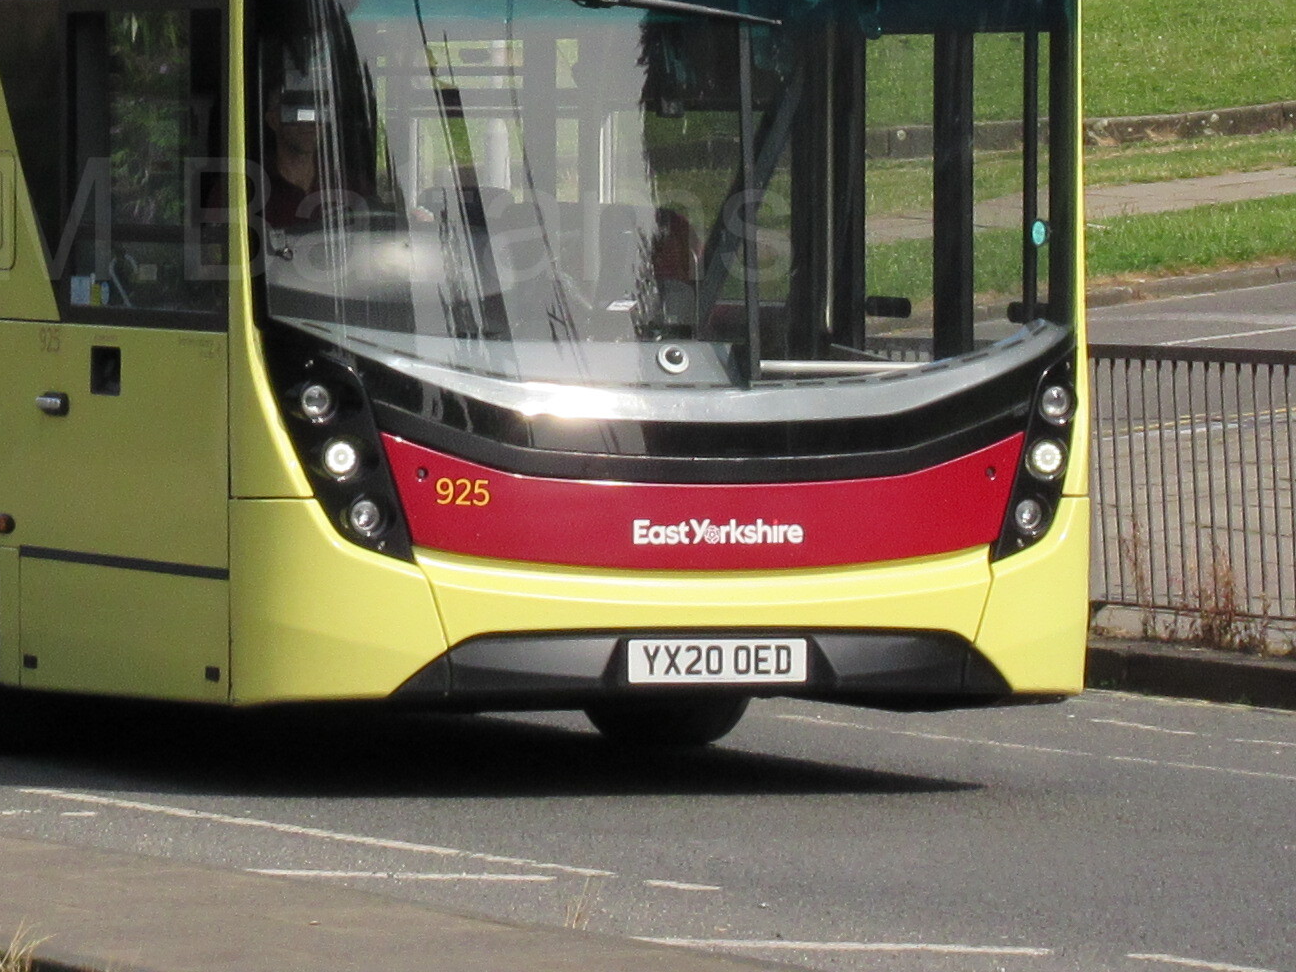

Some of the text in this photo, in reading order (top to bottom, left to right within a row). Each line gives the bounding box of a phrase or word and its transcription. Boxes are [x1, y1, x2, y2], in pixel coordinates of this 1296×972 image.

[435, 477, 491, 506] 925
[642, 645, 792, 676] YX20 OED
